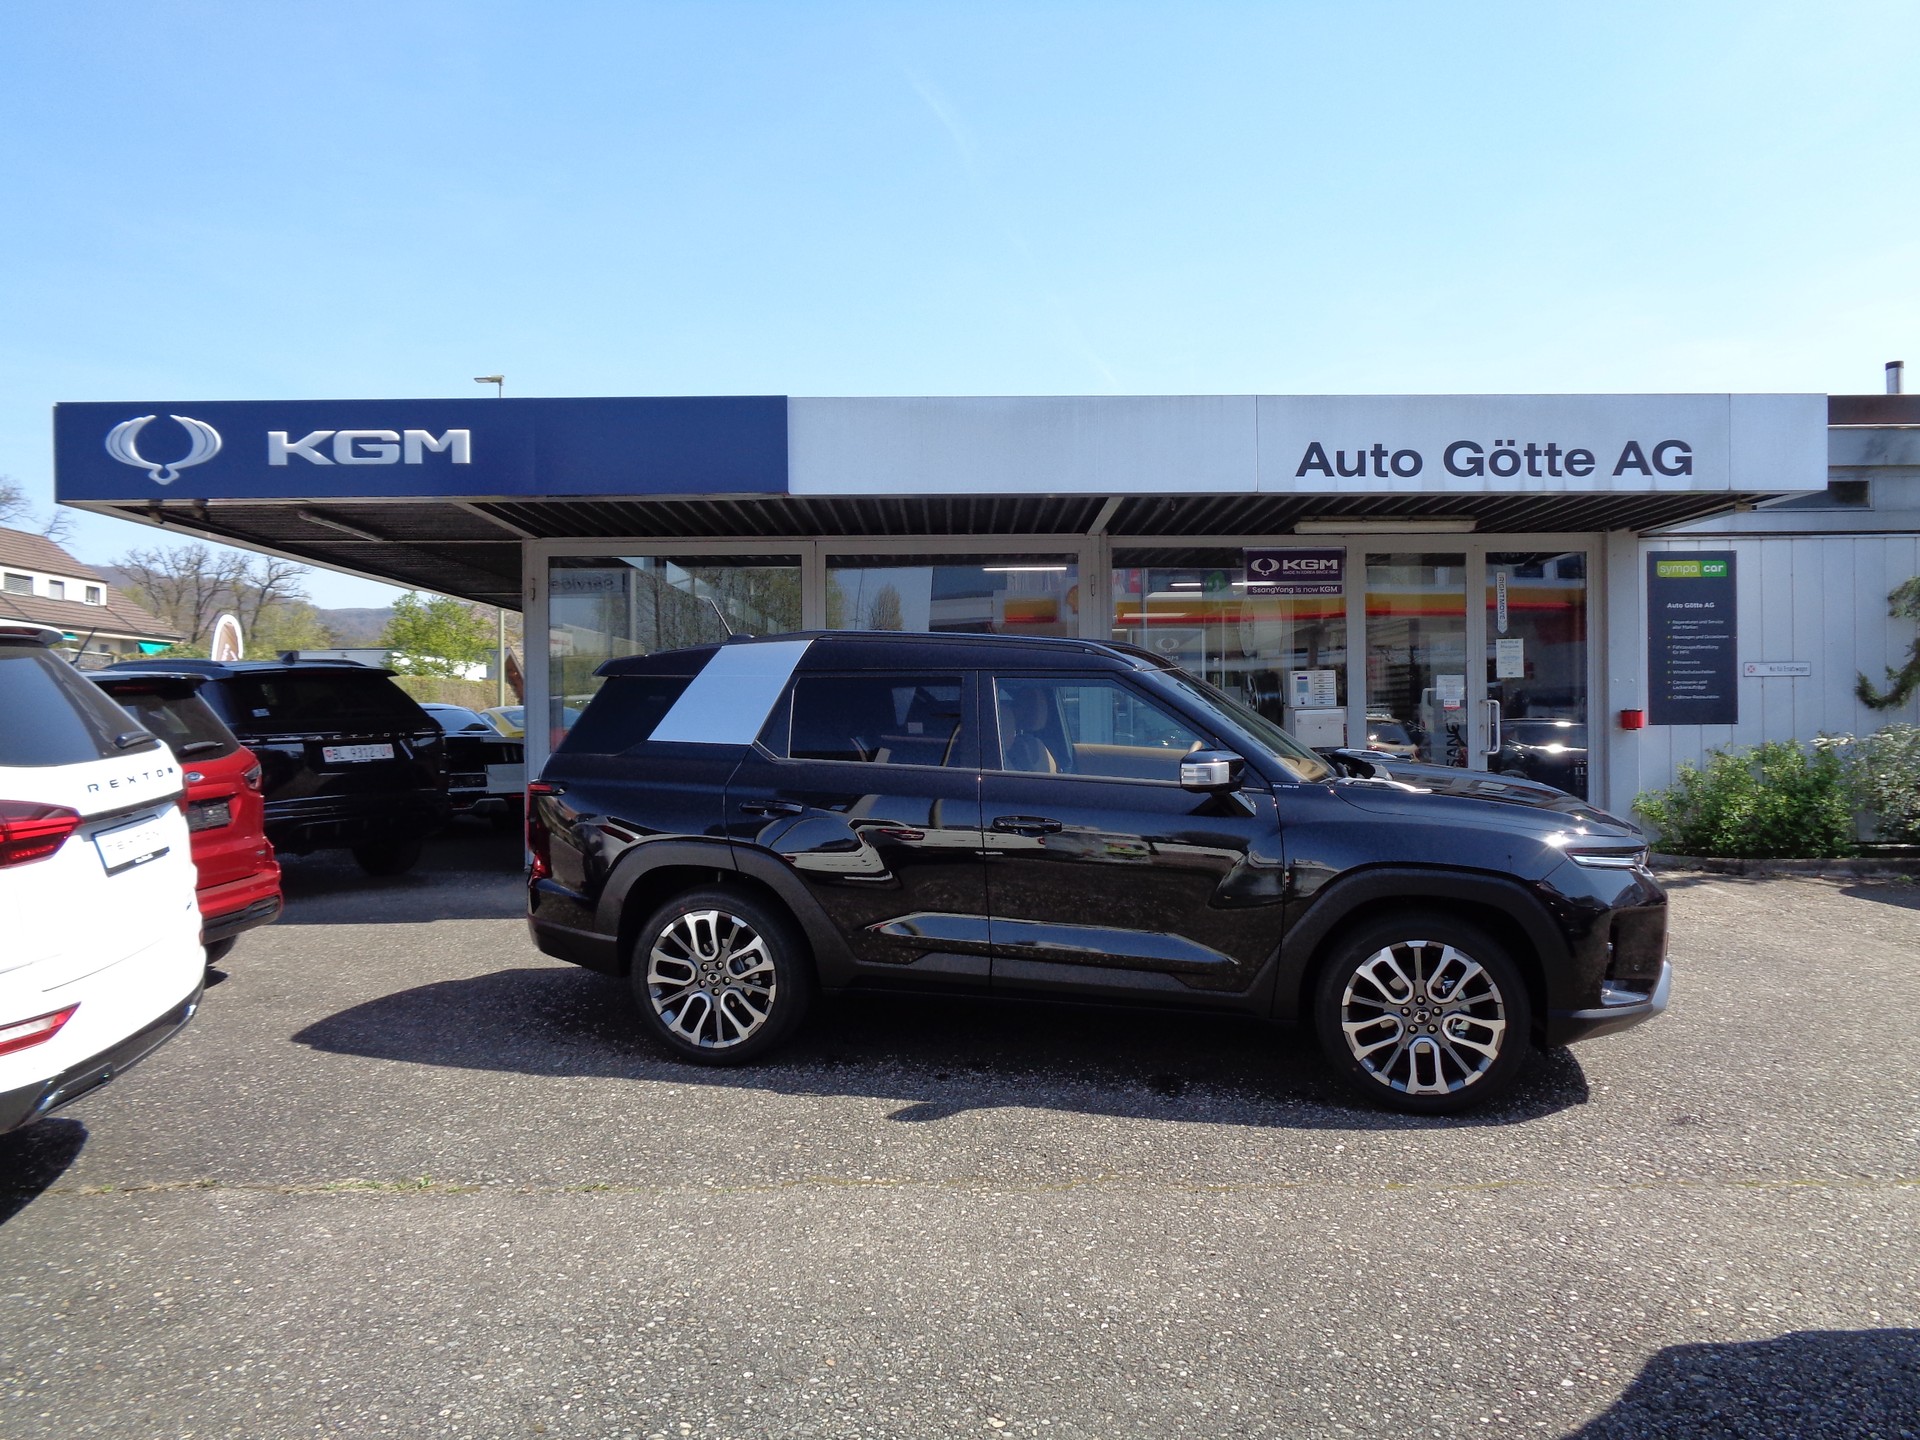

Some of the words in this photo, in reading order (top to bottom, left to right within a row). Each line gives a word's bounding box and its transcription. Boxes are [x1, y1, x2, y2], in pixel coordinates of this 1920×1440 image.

[267, 429, 470, 465] KGM
[1295, 441, 1423, 477] Auto
[1443, 440, 1595, 477] Götte
[1612, 440, 1692, 476] AG
[1283, 560, 1338, 569] KGM
[1660, 565, 1697, 575] sympa
[1252, 586, 1294, 594] SsangYong
[87, 767, 174, 793] REXTON
